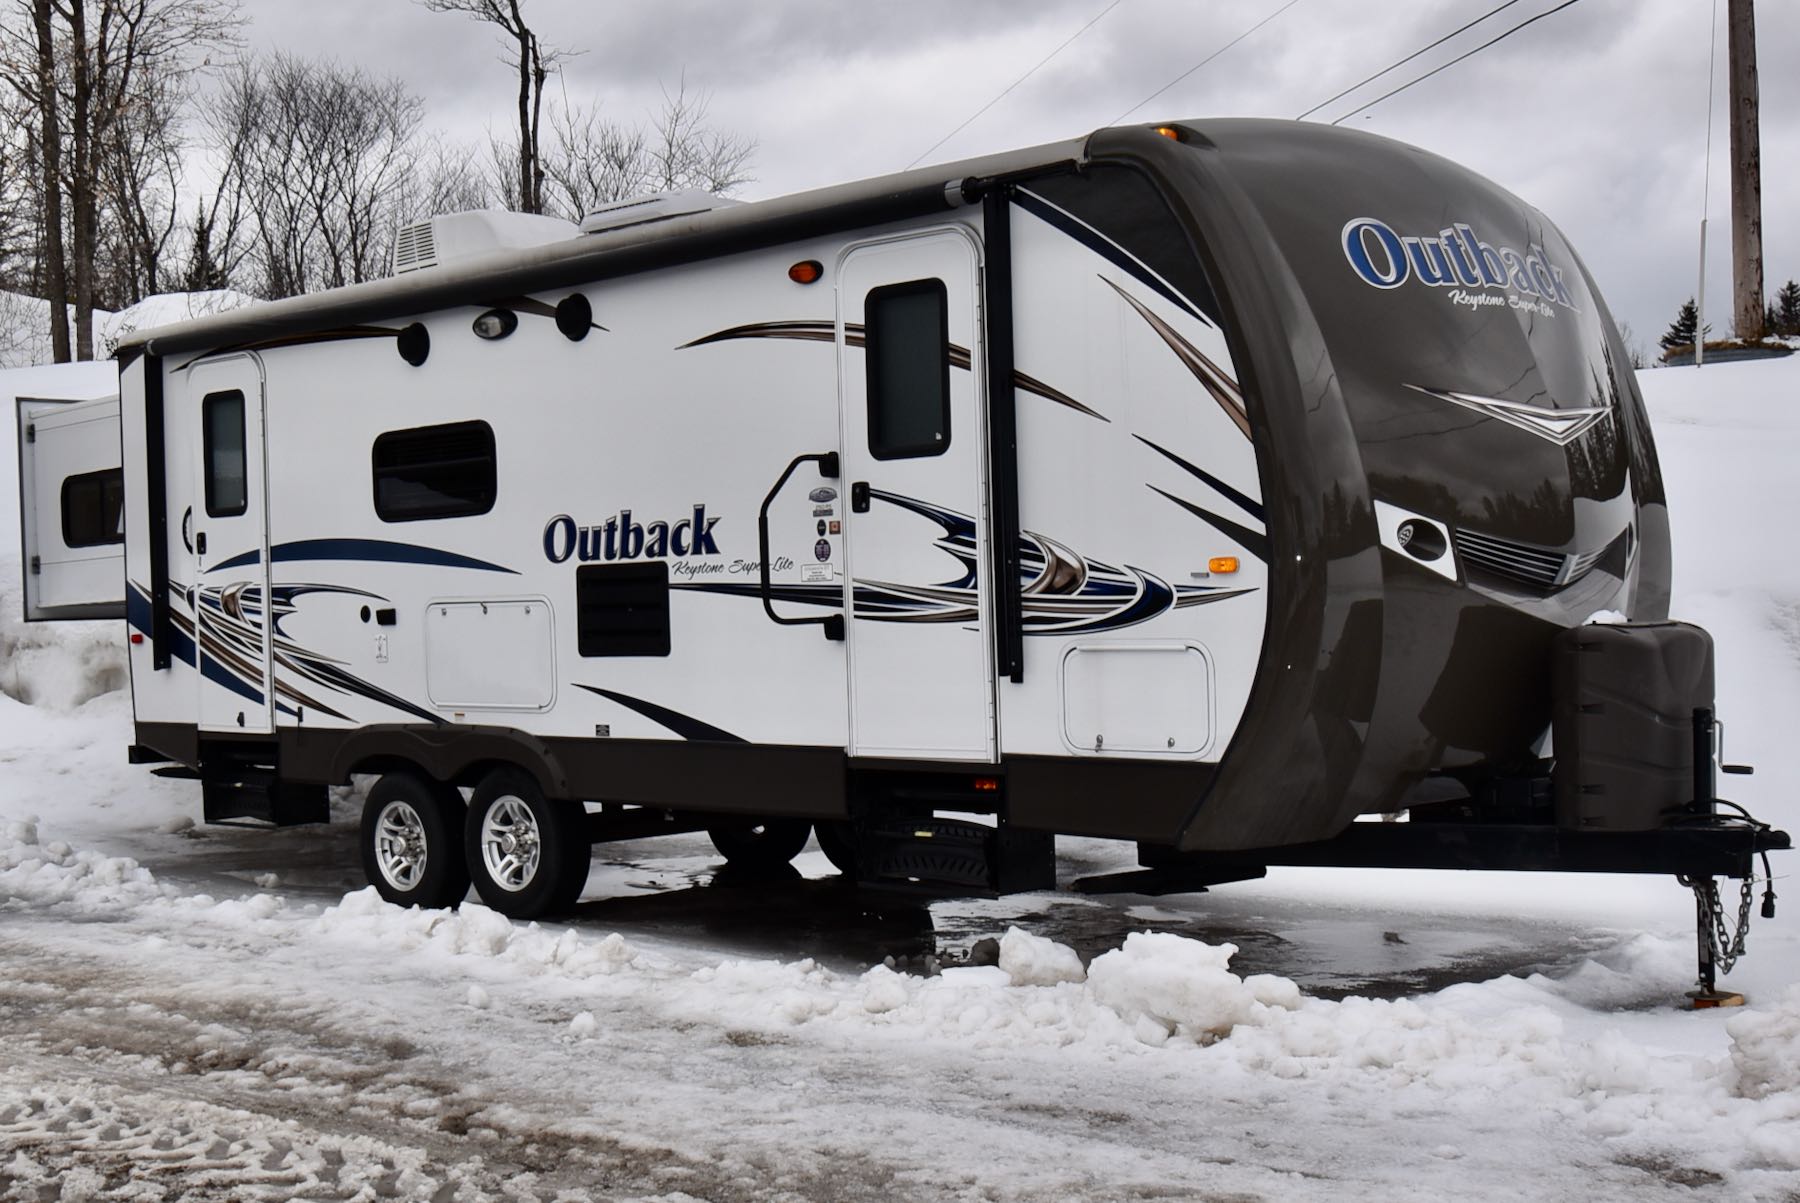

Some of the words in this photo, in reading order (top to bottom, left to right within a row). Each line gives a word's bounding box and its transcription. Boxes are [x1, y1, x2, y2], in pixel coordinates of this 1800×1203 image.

[1341, 217, 1580, 313] Outback
[1448, 290, 1505, 311] Keystone
[543, 504, 722, 564] Outback
[672, 561, 724, 580] Keystone
[728, 556, 795, 576] Supe-Lite
